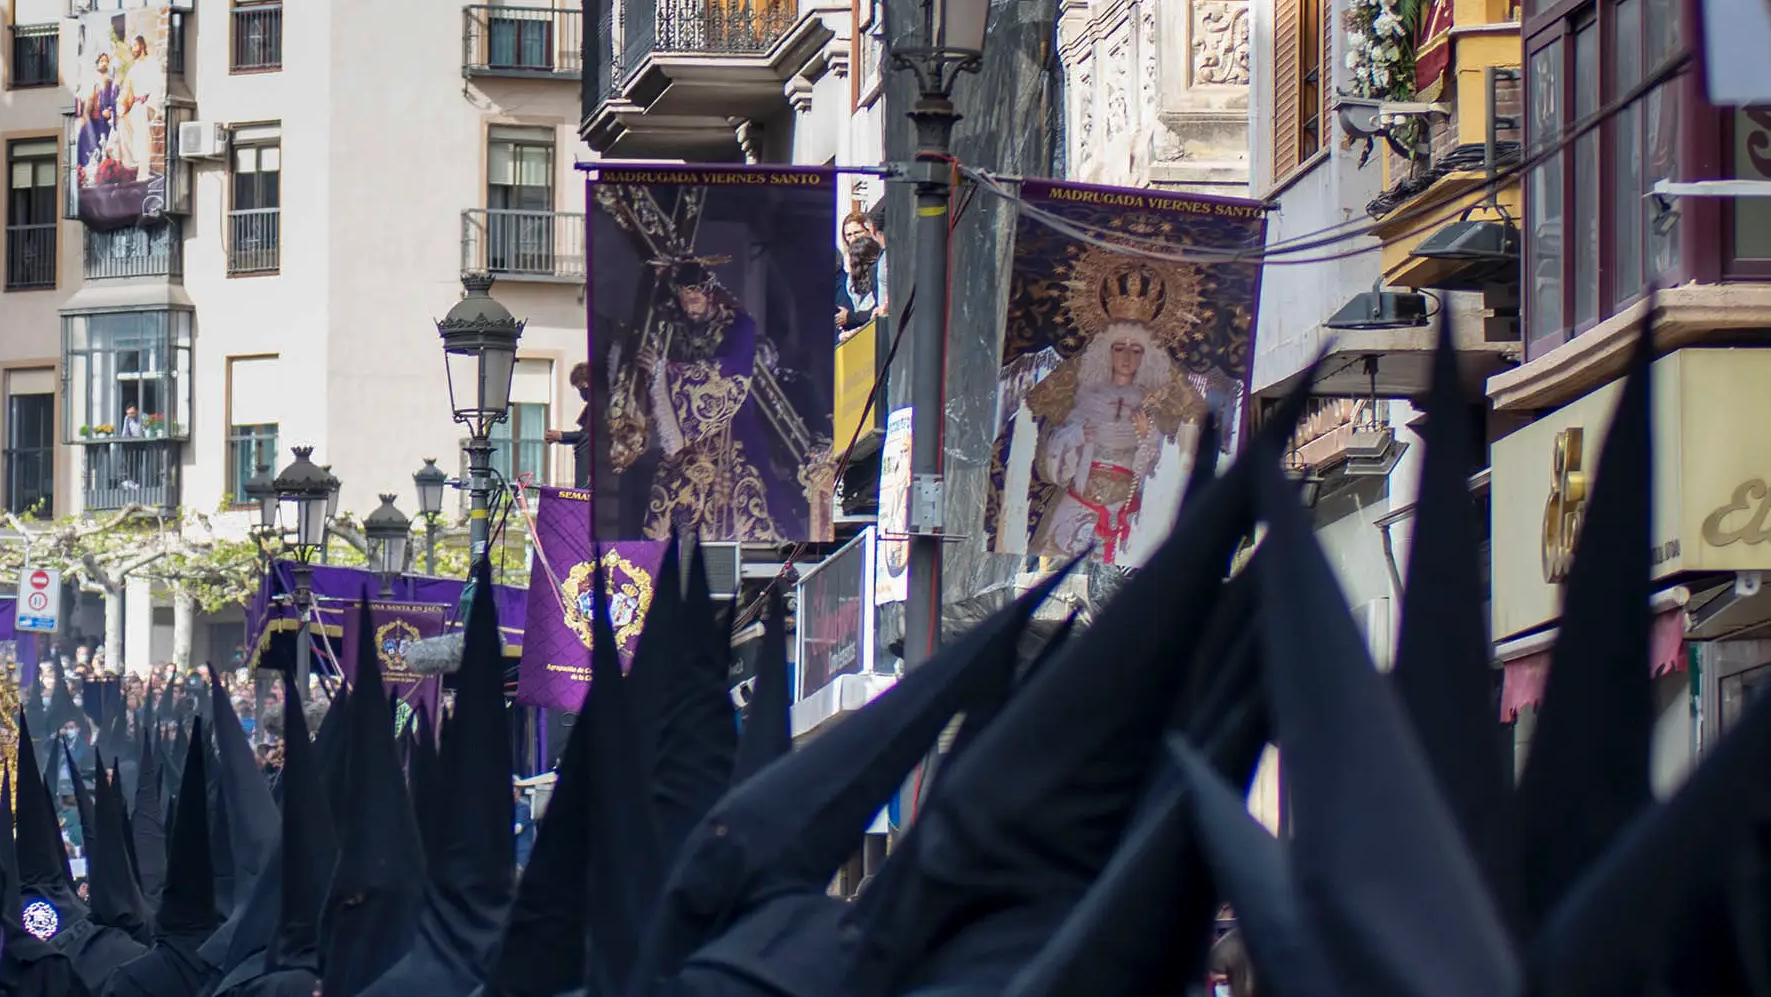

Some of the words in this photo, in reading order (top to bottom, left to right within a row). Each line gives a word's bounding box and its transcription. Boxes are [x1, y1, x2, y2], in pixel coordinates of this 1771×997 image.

[603, 172, 698, 184] MADRUGADA
[702, 172, 766, 184] VIERNES
[770, 173, 821, 185] SANTO
[1049, 187, 1145, 208] MADRUGADA
[1148, 196, 1212, 214] VIERNES
